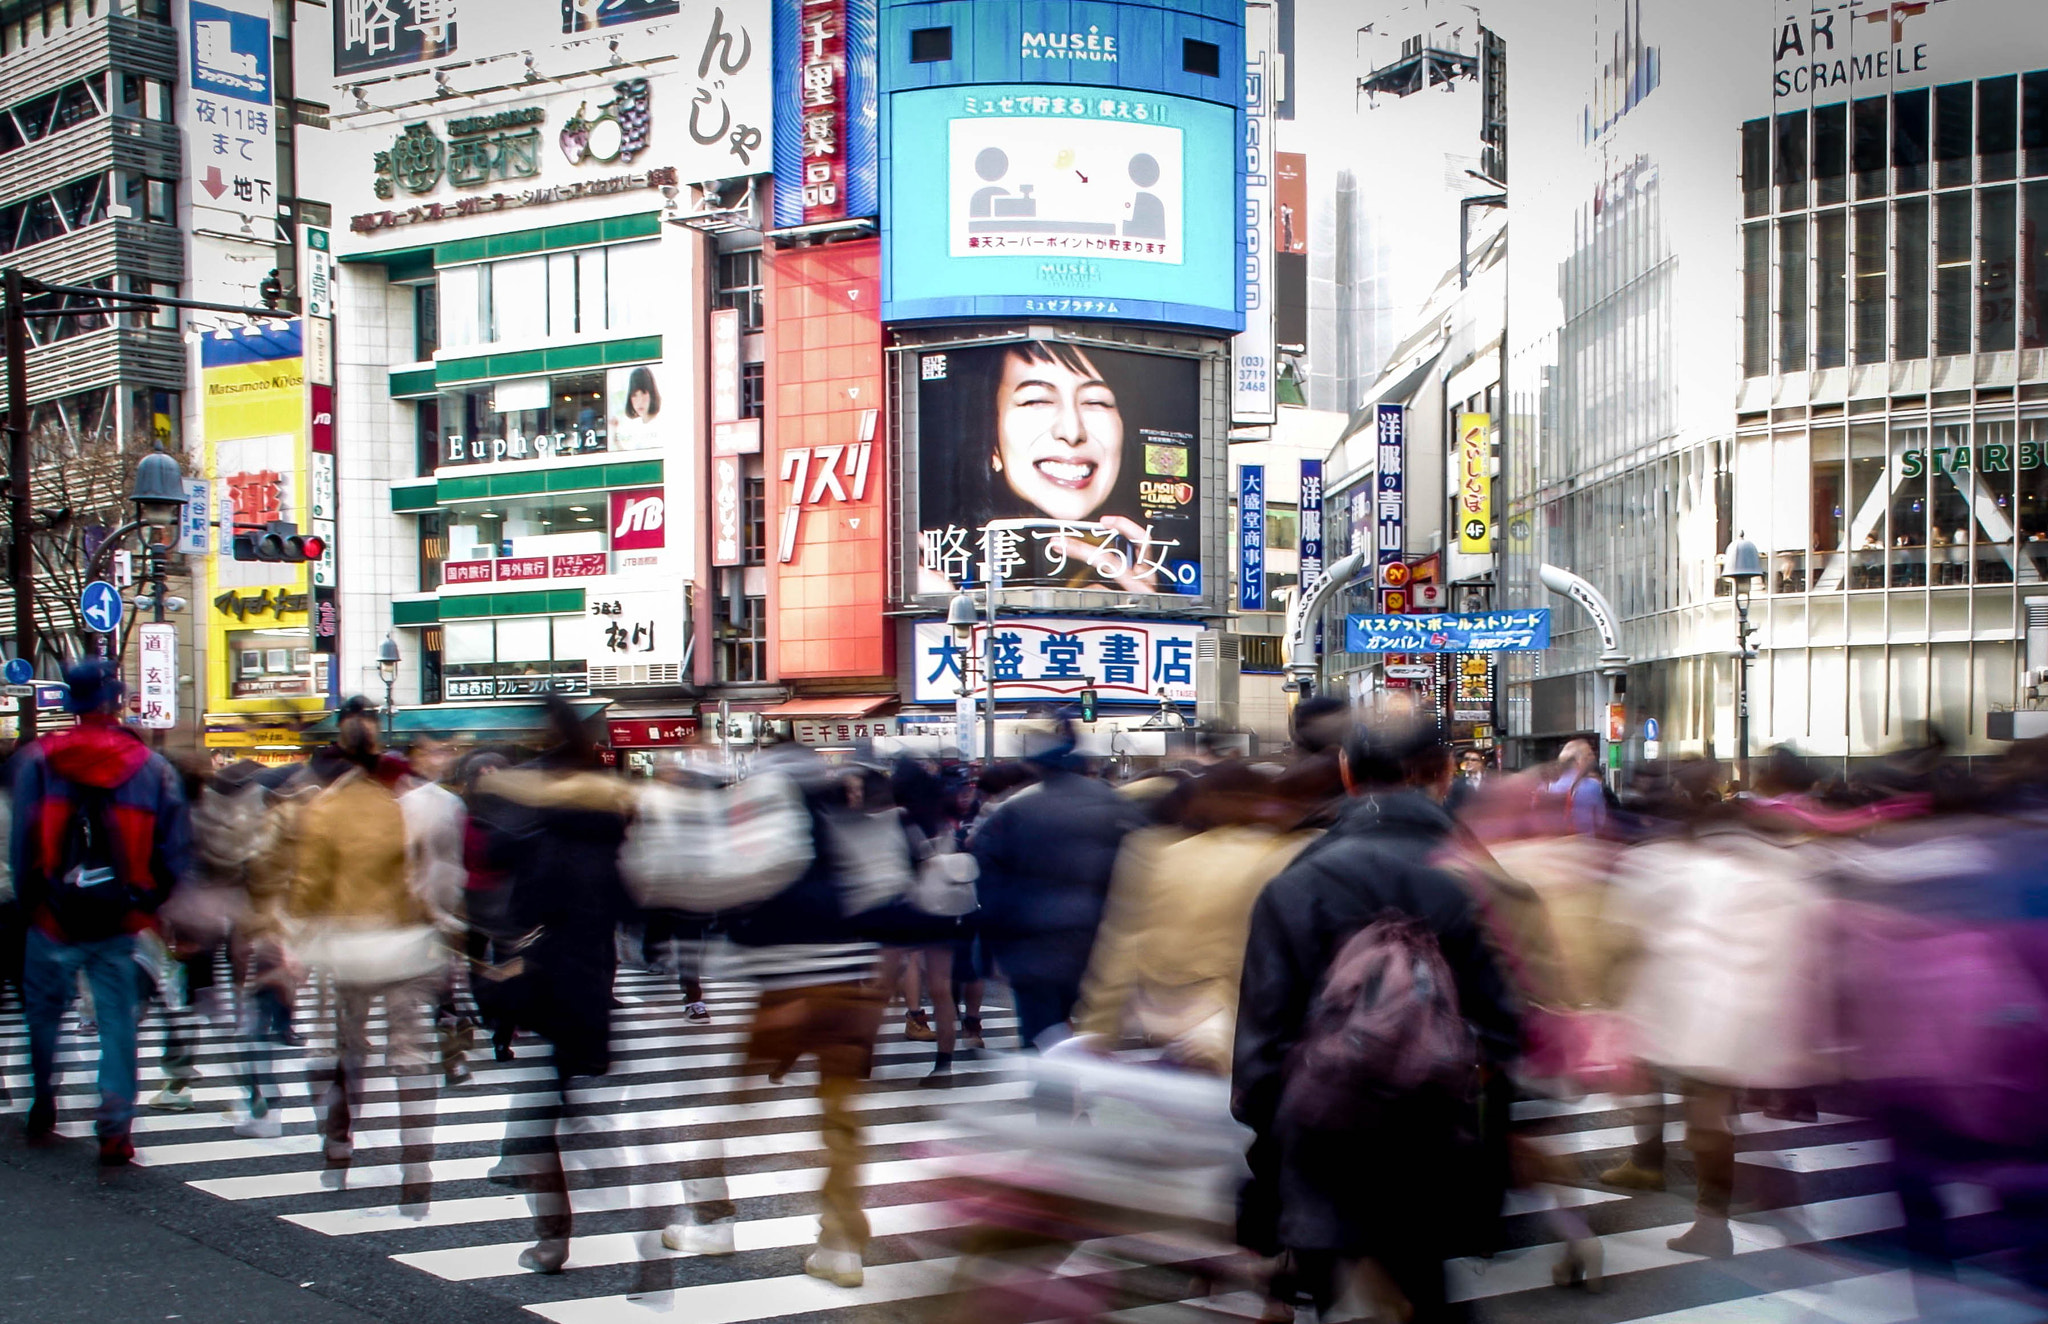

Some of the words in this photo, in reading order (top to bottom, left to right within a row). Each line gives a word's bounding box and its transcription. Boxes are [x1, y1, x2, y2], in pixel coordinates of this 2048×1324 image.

[1022, 49, 1117, 63] PLATINUM
[1775, 44, 1928, 97] SCRAMBLE
[690, 7, 762, 166] んじゃ
[196, 98, 268, 135] 夜11時
[802, 0, 836, 207] 千里薬品
[234, 175, 271, 204] 地下
[1025, 300, 1119, 314] ミュゼプラチナム
[1239, 370, 1265, 380] 3719
[1241, 356, 1264, 368] (03)
[208, 380, 270, 395] Matsumoto
[1239, 382, 1265, 392] 2468
[313, 412, 331, 425] JTB
[448, 427, 599, 462] Euphoria
[1901, 441, 2048, 478] STARB
[777, 408, 878, 563] クスリ
[1379, 413, 1402, 550] 洋服の青山
[615, 497, 664, 538] JTB
[1466, 523, 1484, 537] 4F
[1244, 475, 1260, 600] 大盛堂商事ビル
[1302, 476, 1321, 589] 洋服の青
[557, 555, 601, 566] ハネムーン
[922, 520, 1197, 585] 略奪する女。
[447, 565, 490, 580] 国内旅行
[500, 561, 545, 577] 海外旅行
[1358, 614, 1541, 632] バスケットボールストリート
[927, 632, 1196, 685] 大盛堂書店
[145, 634, 162, 718] 道玄坂
[449, 681, 493, 695] 渋谷西村
[498, 678, 587, 694] フルーツパーラー
